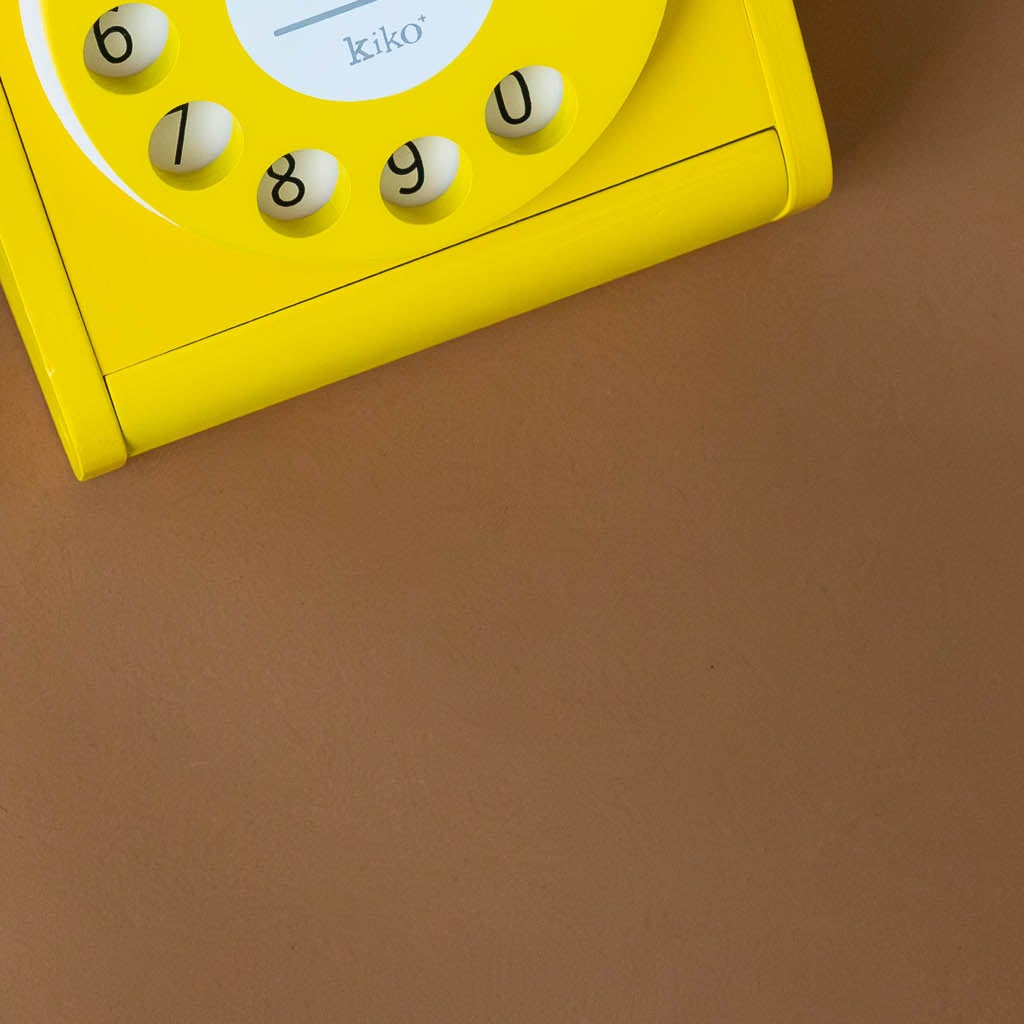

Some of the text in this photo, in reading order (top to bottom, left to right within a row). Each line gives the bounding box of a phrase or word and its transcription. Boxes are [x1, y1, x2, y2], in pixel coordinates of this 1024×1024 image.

[93, 6, 133, 64] 6
[493, 70, 532, 125] 0
[165, 102, 189, 166] 7
[266, 153, 306, 208] 8
[387, 140, 425, 195] 9
